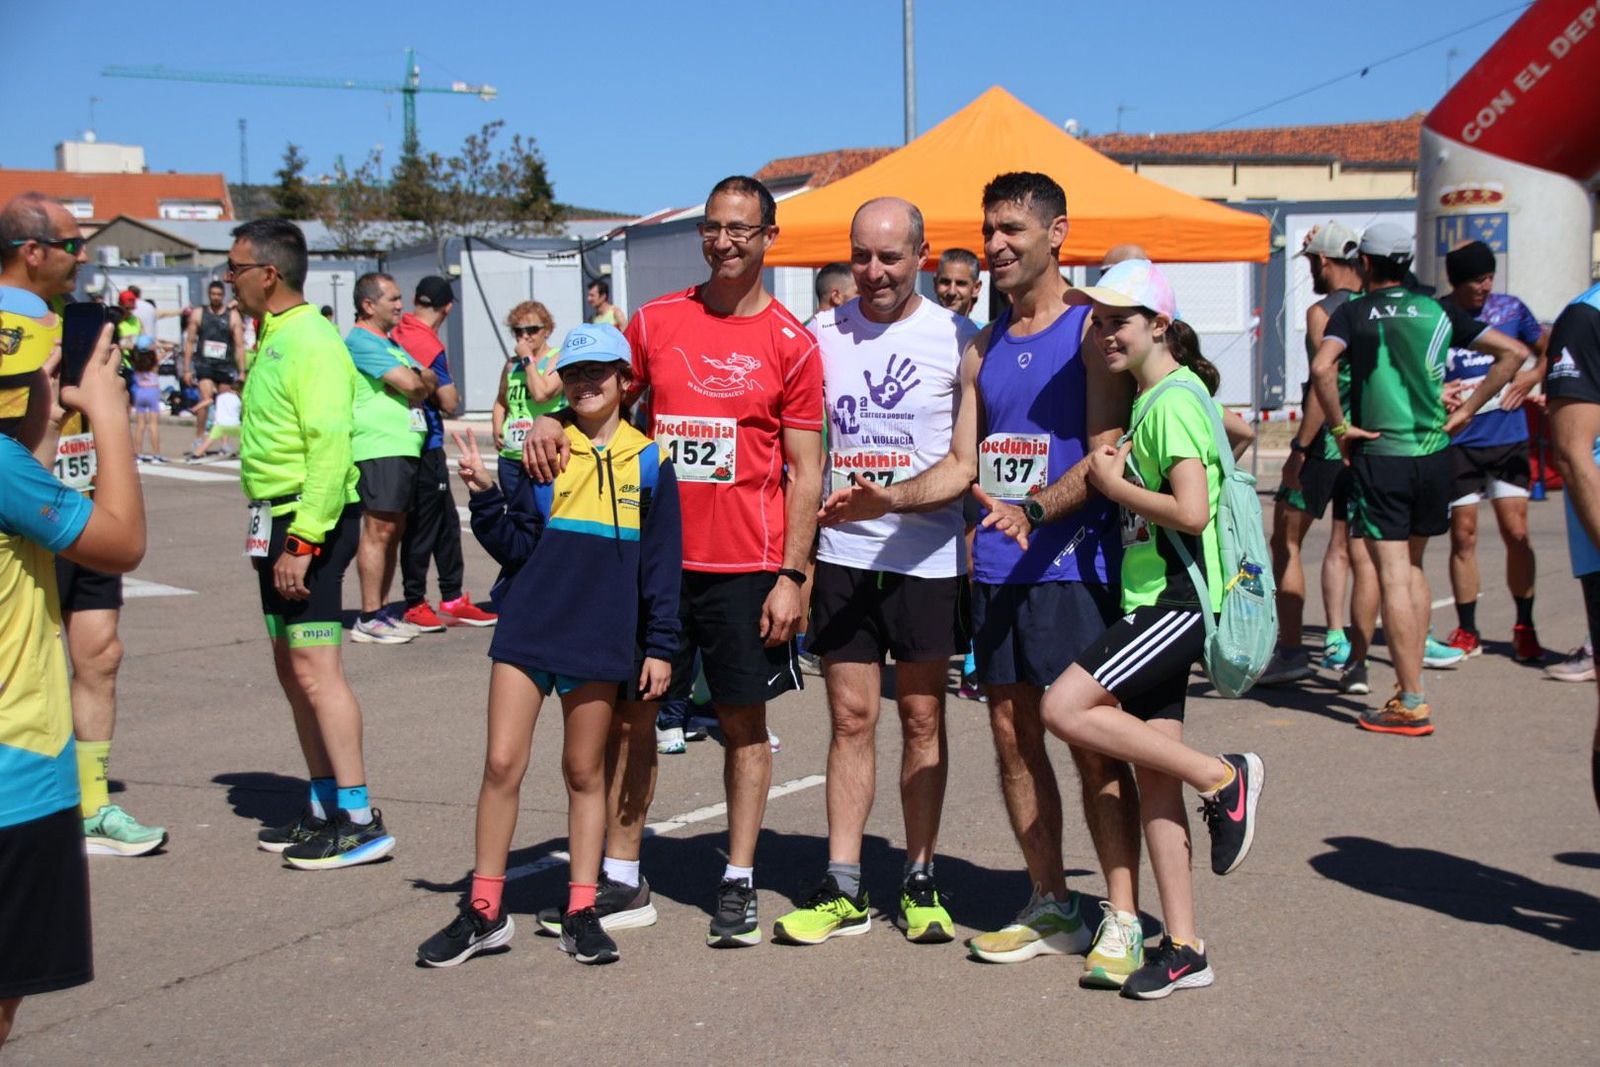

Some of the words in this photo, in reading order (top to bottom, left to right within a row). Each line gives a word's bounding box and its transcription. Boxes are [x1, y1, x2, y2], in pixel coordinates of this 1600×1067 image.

[1461, 89, 1516, 143] CON
[1513, 61, 1552, 93] EL
[887, 413, 915, 421] popular
[511, 430, 530, 442] 12
[656, 419, 734, 439] bedunia
[861, 435, 871, 445] LA
[872, 435, 914, 446] VIOLENCIA
[668, 440, 717, 466] 152
[833, 451, 911, 469] bedunia
[54, 455, 90, 479] 155
[993, 457, 1034, 483] 137
